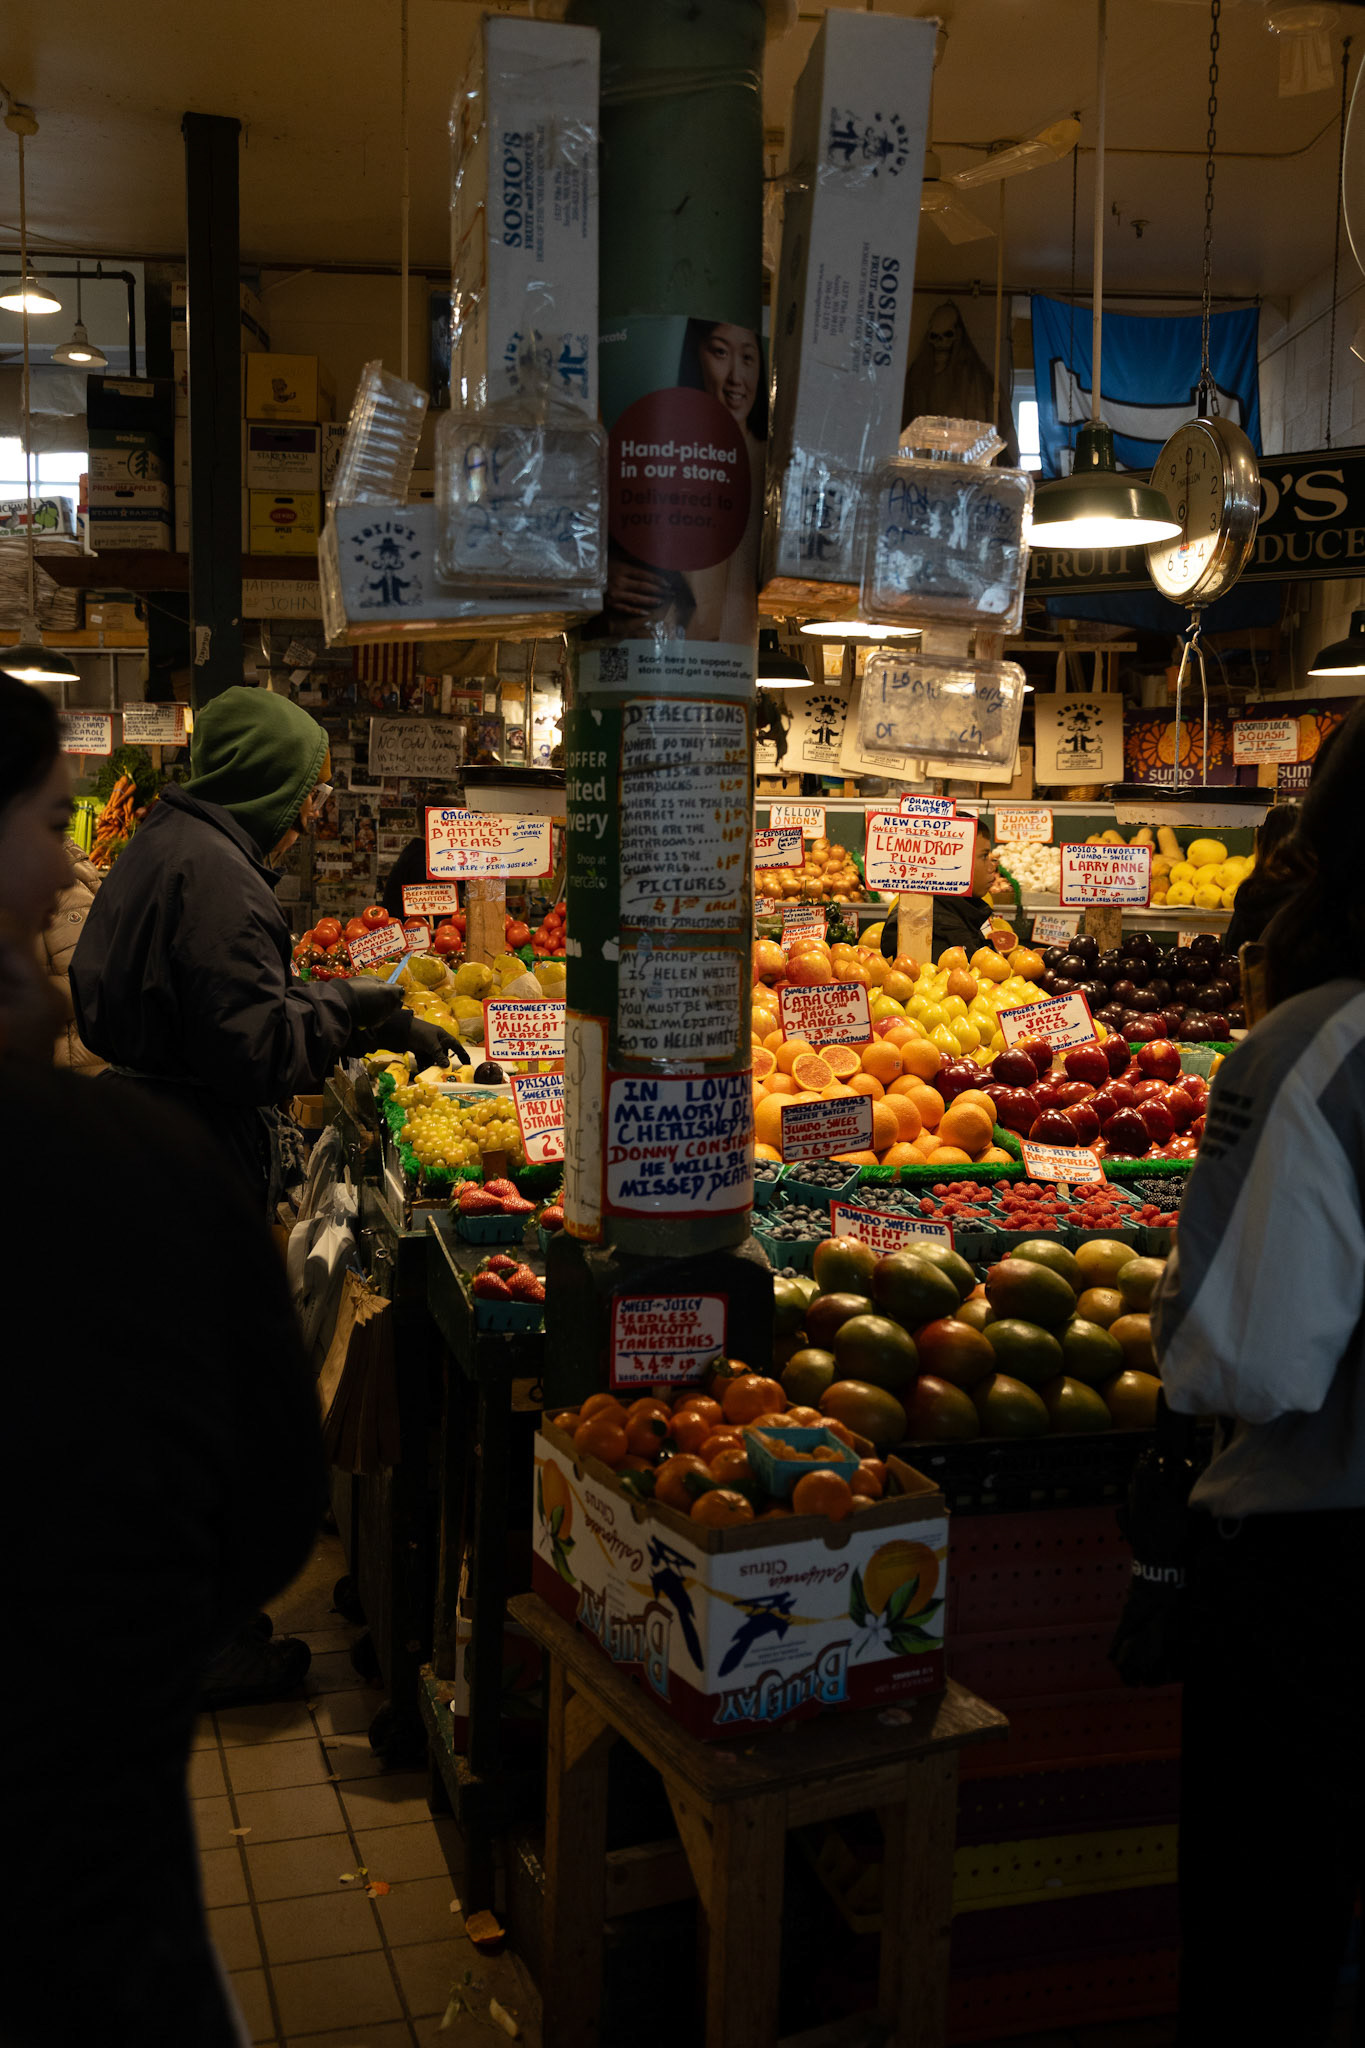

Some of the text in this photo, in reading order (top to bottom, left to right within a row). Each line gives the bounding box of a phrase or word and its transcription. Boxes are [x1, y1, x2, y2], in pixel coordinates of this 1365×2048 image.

[503, 132, 523, 248] SOSIO'S
[525, 192, 534, 249] FRUIT and
[867, 255, 880, 309] FRUIT and
[874, 257, 900, 367] SOSIO'S
[621, 440, 736, 464] Hand-picked
[1186, 448, 1192, 465] 0
[1202, 452, 1206, 469] 1
[621, 461, 731, 483] in our store.
[1170, 464, 1177, 481] 9
[92, 484, 157, 492] PREMIUM APPLES
[1210, 476, 1218, 495] 2
[621, 488, 733, 511] Delivered to
[620, 510, 717, 528] your door.
[1210, 512, 1217, 531] 3
[1028, 528, 1365, 581] FRUIT DUCE
[1168, 553, 1173, 571] 6
[1183, 560, 1188, 577] 5
[665, 655, 730, 667] here to support
[638, 666, 738, 679] store and get special
[623, 705, 744, 728] DIRECTIONS
[381, 722, 424, 737] Congrats
[876, 722, 897, 740] or
[1238, 731, 1285, 741] SQUASH
[624, 737, 741, 753] WHERE DO THEY THROW
[626, 753, 692, 766] THE FISH
[666, 765, 701, 777] IS THE
[624, 780, 693, 796] STARBUCKS
[622, 799, 656, 811] WHERE
[661, 799, 674, 808] IS
[679, 799, 697, 808] THE
[922, 799, 934, 807] MY
[623, 811, 675, 821] MARKET
[775, 807, 821, 817] YELLOW
[775, 816, 818, 825] ONIONS
[884, 817, 951, 829] NEW CROP
[431, 827, 512, 841] BARTLETT
[622, 824, 705, 837] WHERE ARE THE
[450, 838, 502, 848] PEARS
[622, 837, 695, 849] BATHROOMS
[876, 834, 964, 855] LEMON DROP
[577, 854, 607, 866] Shop at
[620, 852, 701, 863] WHERE IS THE
[891, 853, 936, 865] PLUMS
[1070, 861, 1144, 873] LARRY ANNE
[570, 875, 608, 889] mercato
[637, 878, 726, 894] PICTURES
[1083, 874, 1135, 885] PLUMS
[406, 895, 453, 903] TOMATOES
[705, 899, 736, 912] EACH
[673, 916, 725, 929] DIRECTIONS
[352, 929, 394, 951] CAMPARI
[1036, 928, 1070, 937] POTATOES
[351, 934, 395, 956] TOMATOES
[620, 952, 697, 971] MY BACKUP
[628, 967, 697, 980] IS HELEN
[620, 984, 738, 999] IF THINK THAT
[783, 990, 860, 1010] CARA CARA
[1038, 995, 1073, 1010] FAVORITE
[496, 1012, 556, 1020] SEEDLESS
[620, 1002, 680, 1015] YOU MUST
[801, 1009, 838, 1020] NAVEL
[1013, 1003, 1068, 1022] EXTRA CRISP
[627, 1019, 646, 1028] ON
[785, 1013, 856, 1030] ORANGES
[1025, 1012, 1064, 1029] JAZZ
[1018, 1020, 1069, 1040] APPLES
[618, 1033, 701, 1050] GO TO HELEN
[624, 1077, 752, 1101] IN LOVIN
[831, 1096, 865, 1107] FARMS
[615, 1103, 724, 1124] MEMORY
[732, 1099, 748, 1118] OF
[618, 1118, 739, 1145] CHERISHED
[786, 1127, 859, 1143] BLUEBERRIES
[542, 1135, 557, 1156] 2
[609, 1145, 679, 1165] DONNY
[1026, 1152, 1096, 1167] RASPBERRIES
[640, 1151, 745, 1177] HE WILL BE
[619, 1165, 751, 1200] MISSED DEAR
[618, 1312, 698, 1324] SEEDLESS
[617, 1335, 713, 1349] TANGERINES
[585, 1490, 614, 1526] Citrus
[584, 1514, 644, 1572] California
[739, 1559, 787, 1579] Citrus
[767, 1562, 849, 1588] California
